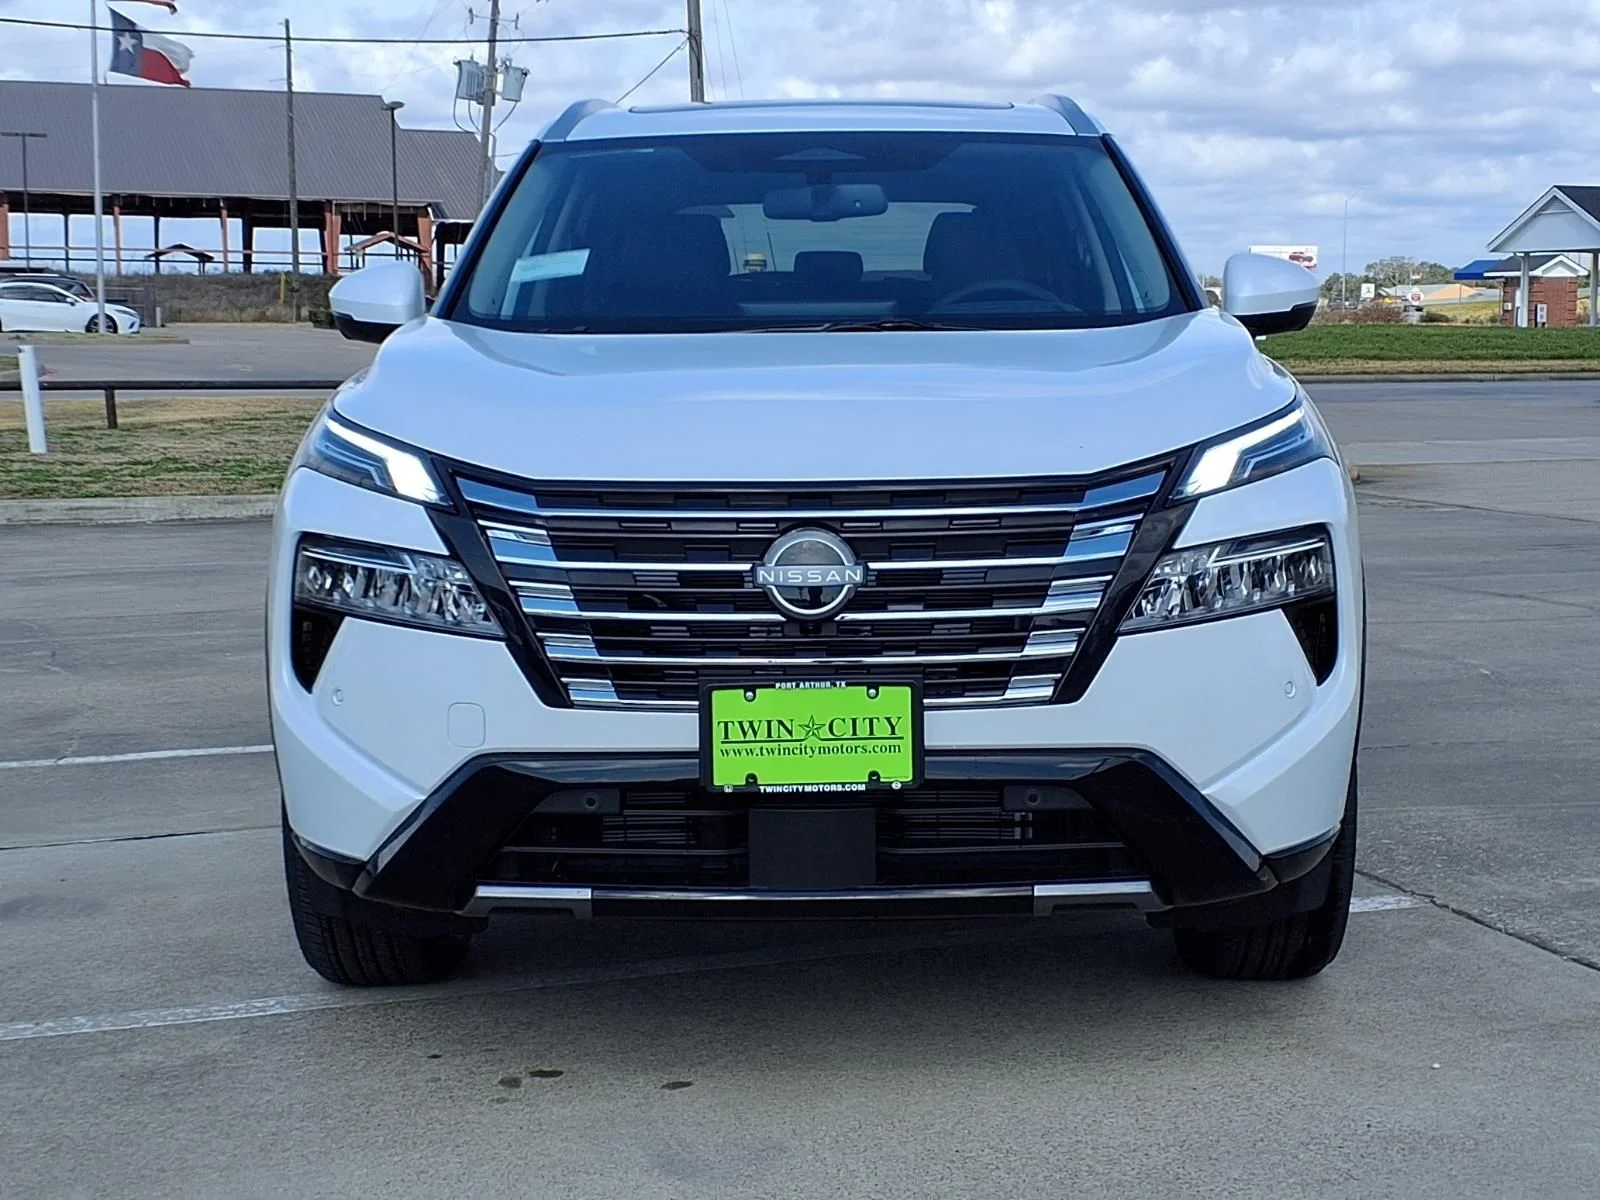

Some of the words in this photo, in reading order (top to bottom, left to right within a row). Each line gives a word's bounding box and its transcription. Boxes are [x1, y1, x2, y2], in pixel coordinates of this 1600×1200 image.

[759, 568, 861, 583] NISSAN
[775, 682, 797, 690] PORT
[835, 680, 847, 688] TX
[718, 718, 795, 740] TWIN
[828, 716, 903, 738] CITY
[719, 742, 902, 758] www.twincitymotors.com
[759, 783, 866, 793] TWINCITYMOTORS.COM
